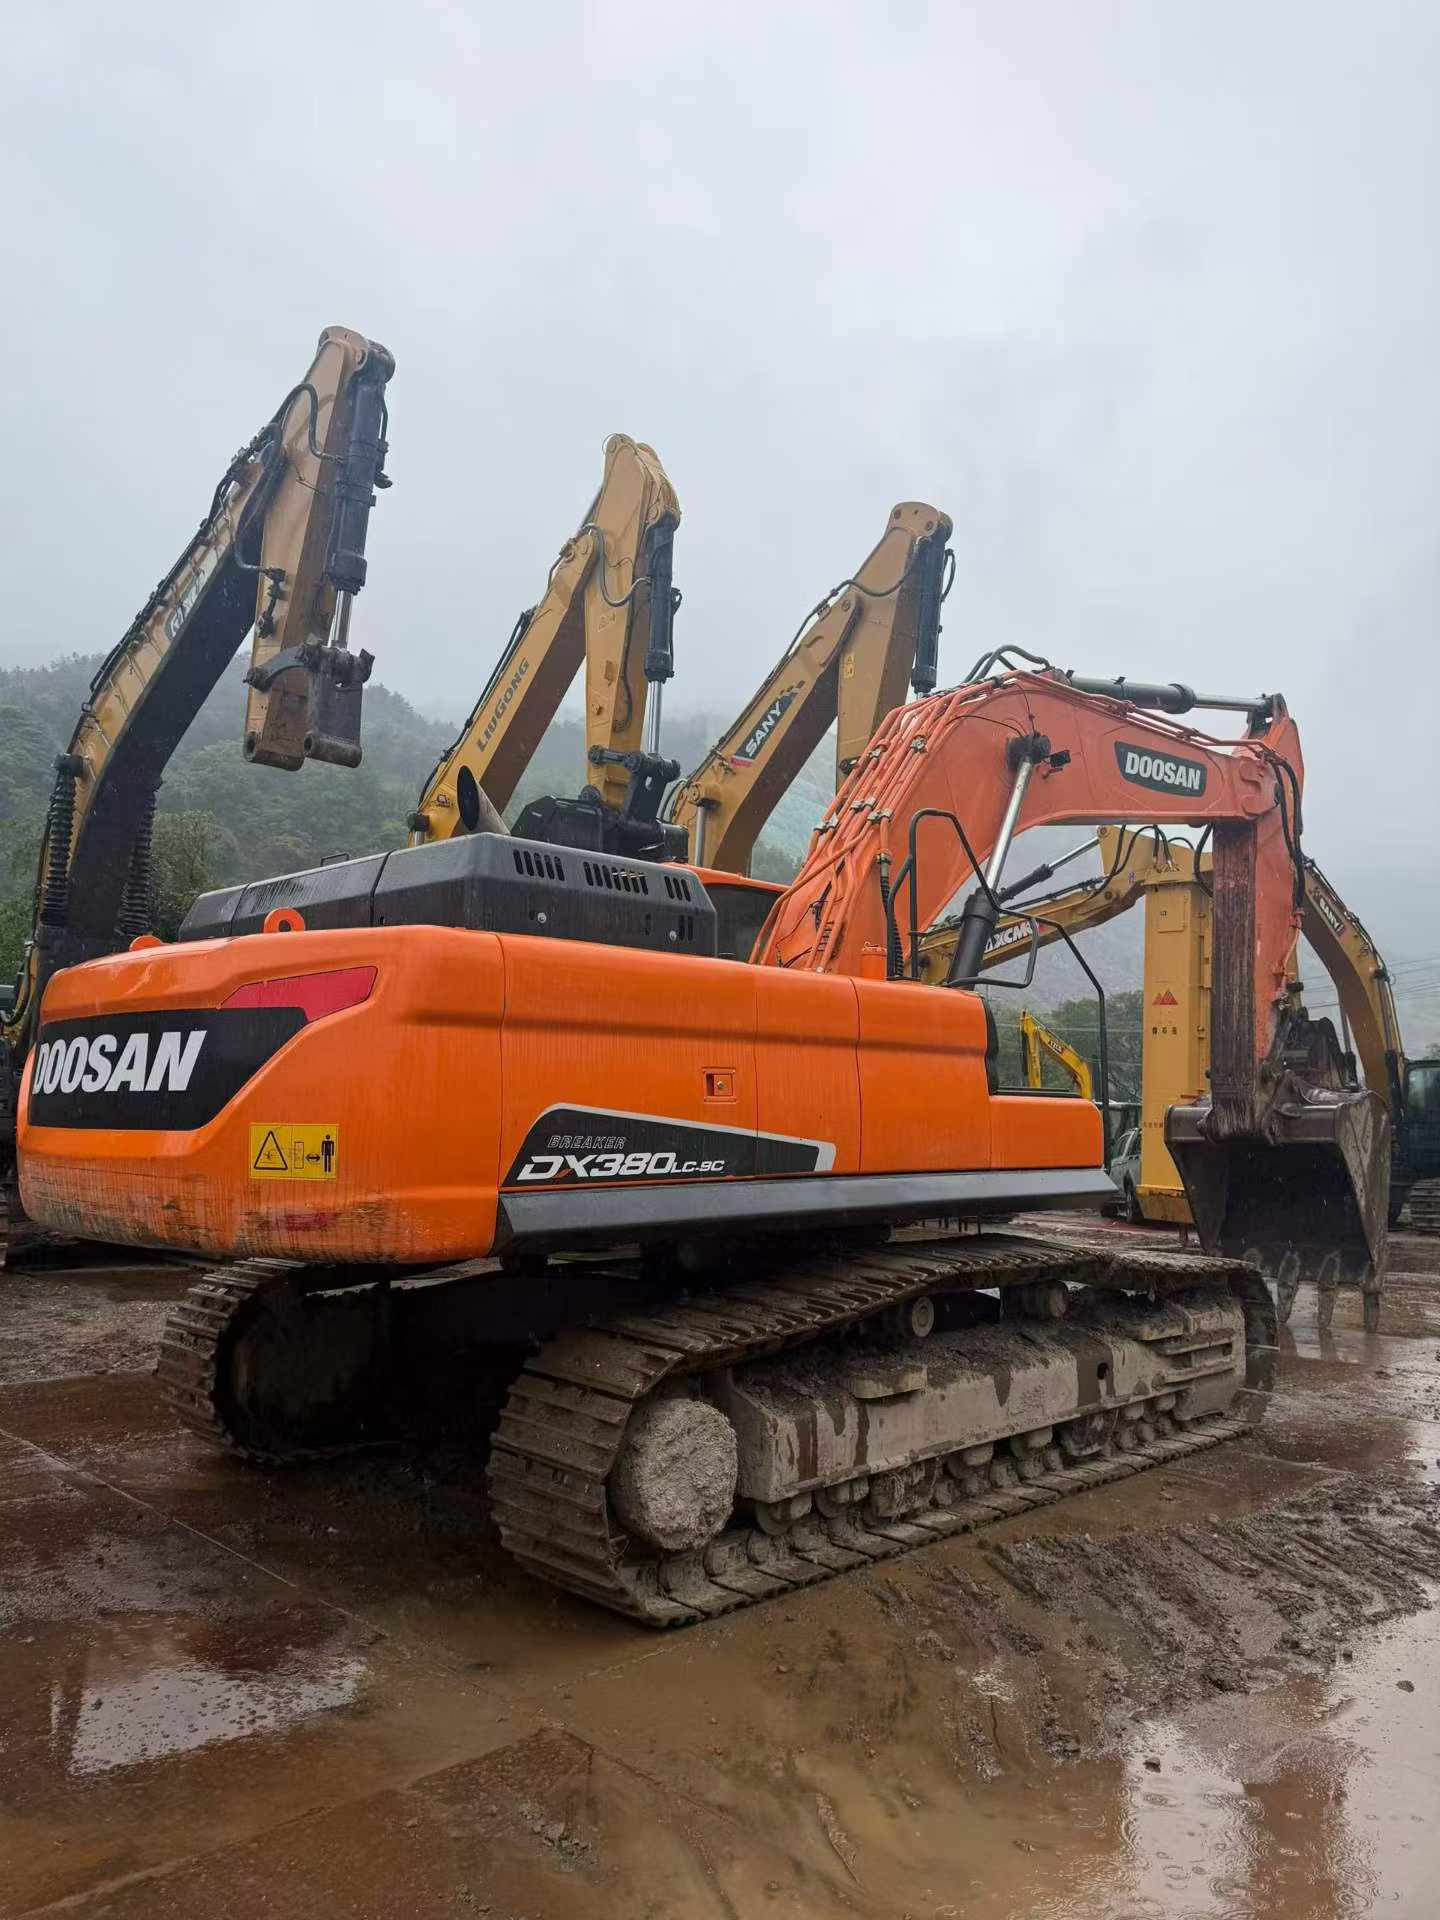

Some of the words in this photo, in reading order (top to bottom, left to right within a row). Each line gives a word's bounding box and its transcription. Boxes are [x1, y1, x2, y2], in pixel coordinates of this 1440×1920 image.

[477, 657, 529, 752] LIUGONG
[745, 700, 781, 757] SANY
[1125, 752, 1201, 790] DOOSAN
[32, 1030, 208, 1095] DOOSAN
[548, 1135, 627, 1150] BREAKER
